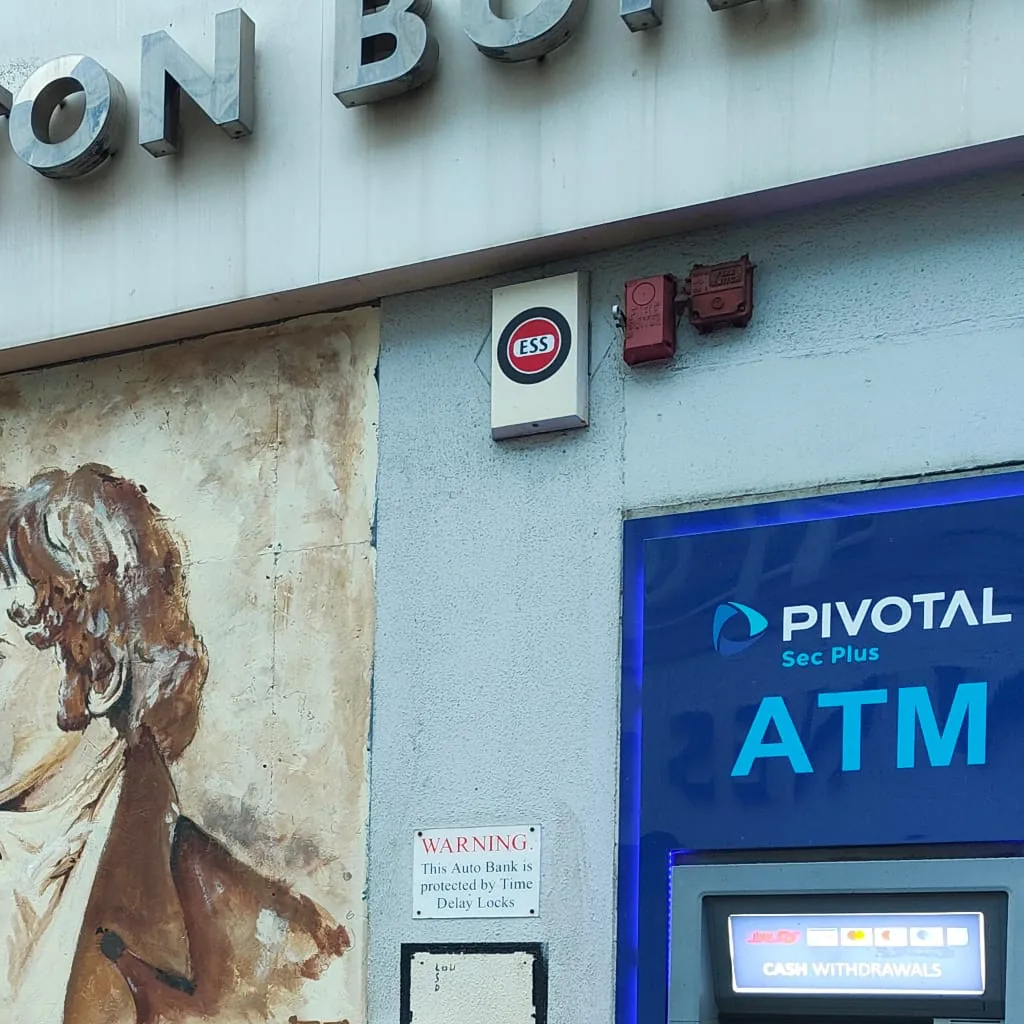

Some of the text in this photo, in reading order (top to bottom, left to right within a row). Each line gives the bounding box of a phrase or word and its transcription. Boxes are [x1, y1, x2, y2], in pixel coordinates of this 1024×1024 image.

[518, 335, 550, 357] ESS
[782, 587, 1012, 642] PIVOTAL
[781, 645, 880, 668] Sec Plus
[730, 682, 988, 777] ATM
[421, 859, 533, 875] This Auto Bank is
[420, 877, 533, 895] protected by Time
[437, 896, 515, 911] Delay Locks
[763, 962, 942, 978] CASH WITHDRAWALS
